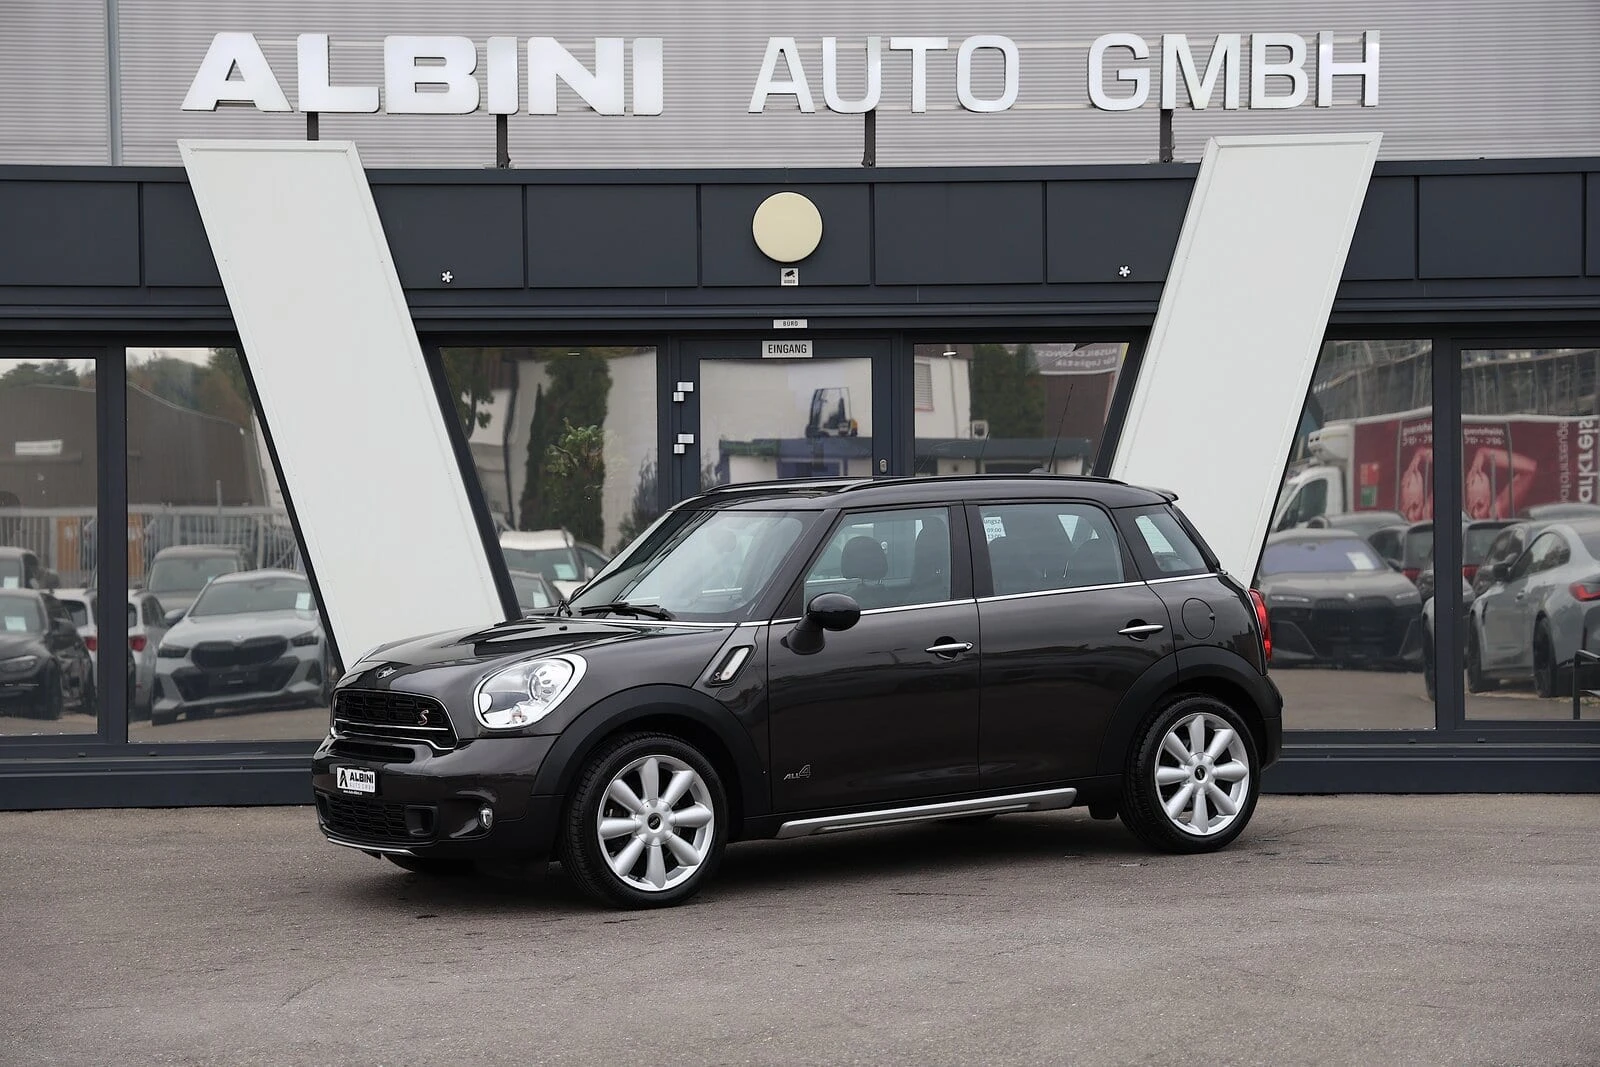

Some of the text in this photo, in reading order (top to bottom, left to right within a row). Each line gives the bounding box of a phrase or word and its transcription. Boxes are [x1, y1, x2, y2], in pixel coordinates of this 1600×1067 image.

[180, 29, 1381, 116] ALBINI AUTO GMBH
[768, 343, 808, 354] EINGANG
[418, 709, 429, 725] S
[350, 771, 374, 784] ALBINI
